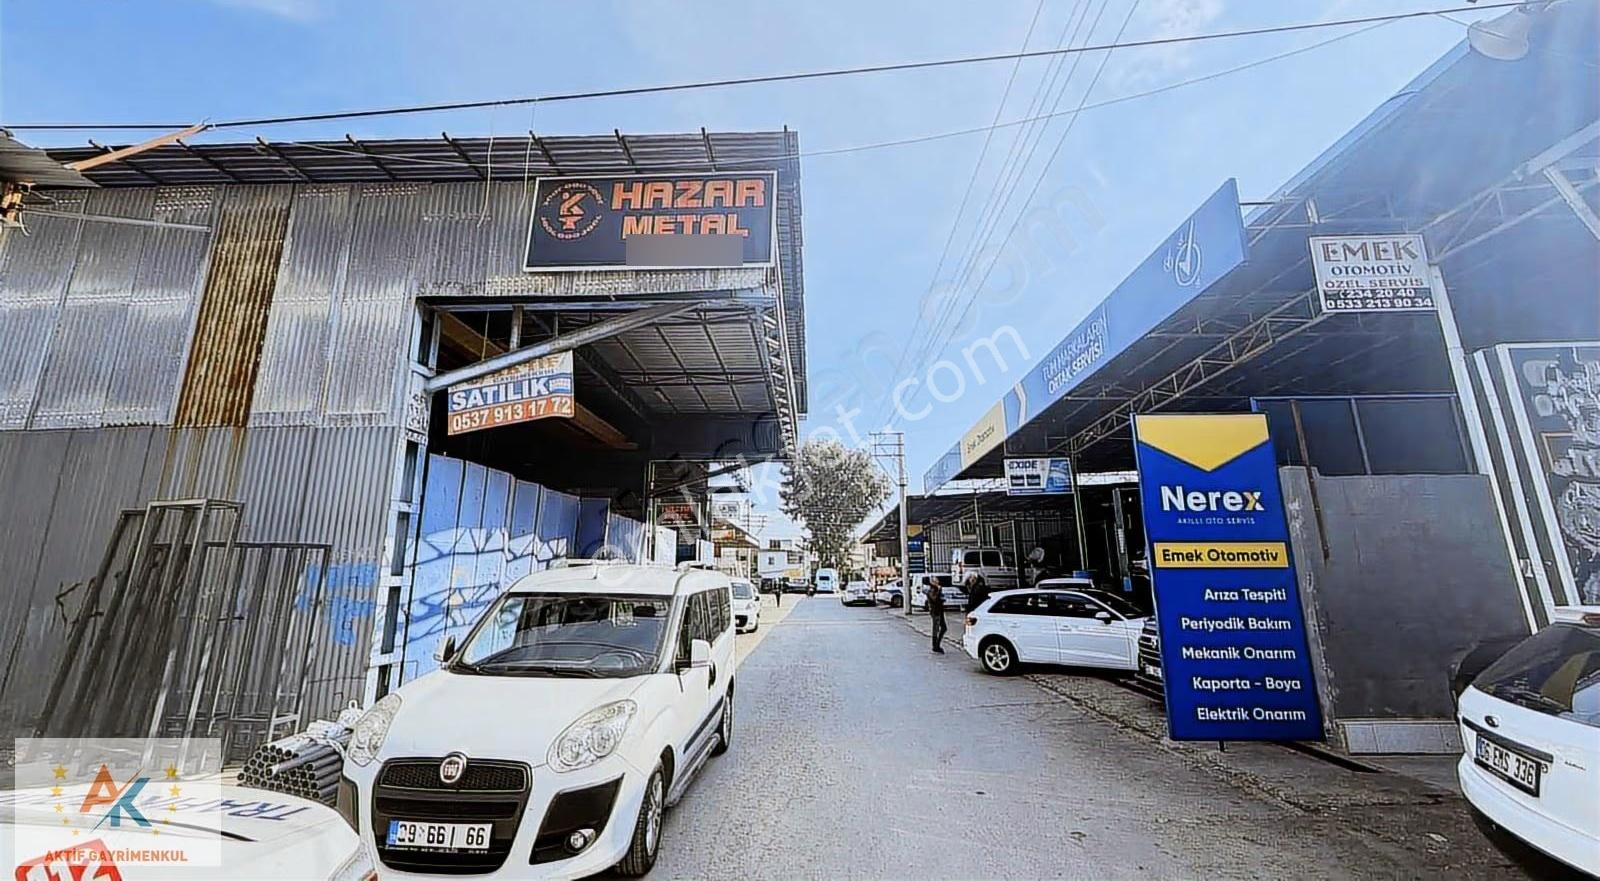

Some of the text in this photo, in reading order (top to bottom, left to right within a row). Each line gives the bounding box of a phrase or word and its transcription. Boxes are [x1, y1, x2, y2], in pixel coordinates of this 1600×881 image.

[611, 179, 765, 210] HAZAR
[621, 213, 749, 239] METAL
[1321, 241, 1418, 262] EMEK
[1396, 288, 1415, 297] 40
[452, 378, 549, 411] SATILIK
[453, 396, 571, 432] 0537 913 17 72
[1009, 460, 1038, 469] EXIDE
[1161, 486, 1264, 511] Nerex
[1162, 548, 1279, 562] Emek Otomotiv
[1204, 588, 1287, 604] Arıza Tespiti
[1181, 617, 1292, 633] Periyodik Bakım
[1182, 646, 1297, 660] Mekanik Onarım
[1192, 676, 1251, 693] Kaporta
[1265, 676, 1301, 692] Boya
[1197, 707, 1306, 721] Elektrik Onarım
[1513, 757, 1535, 786] 336
